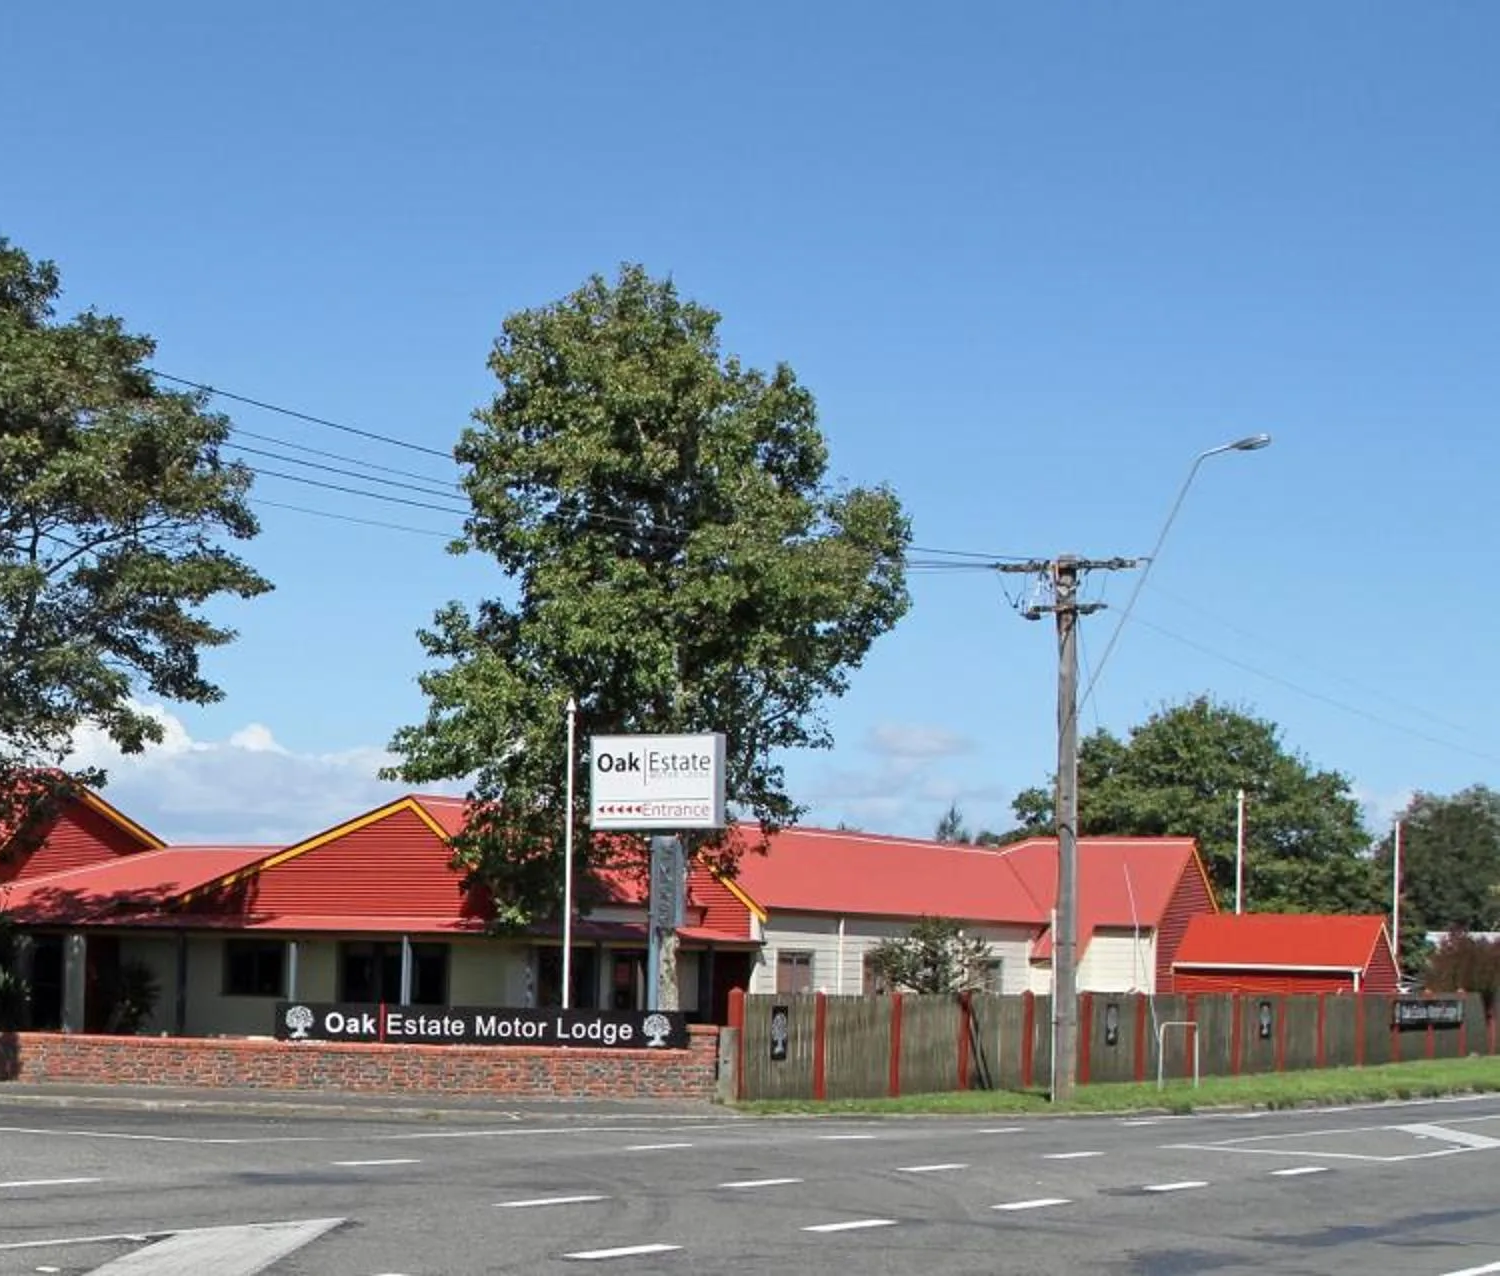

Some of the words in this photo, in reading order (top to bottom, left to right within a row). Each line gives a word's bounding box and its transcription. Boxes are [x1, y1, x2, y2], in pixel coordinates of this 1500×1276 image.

[597, 752, 640, 772] Oak
[649, 751, 711, 771] Estate
[643, 803, 710, 817] Entrance
[325, 1012, 376, 1034] Oak
[387, 1013, 465, 1036] Estate
[475, 1016, 548, 1037] Motor
[556, 1017, 633, 1045] Lodge
